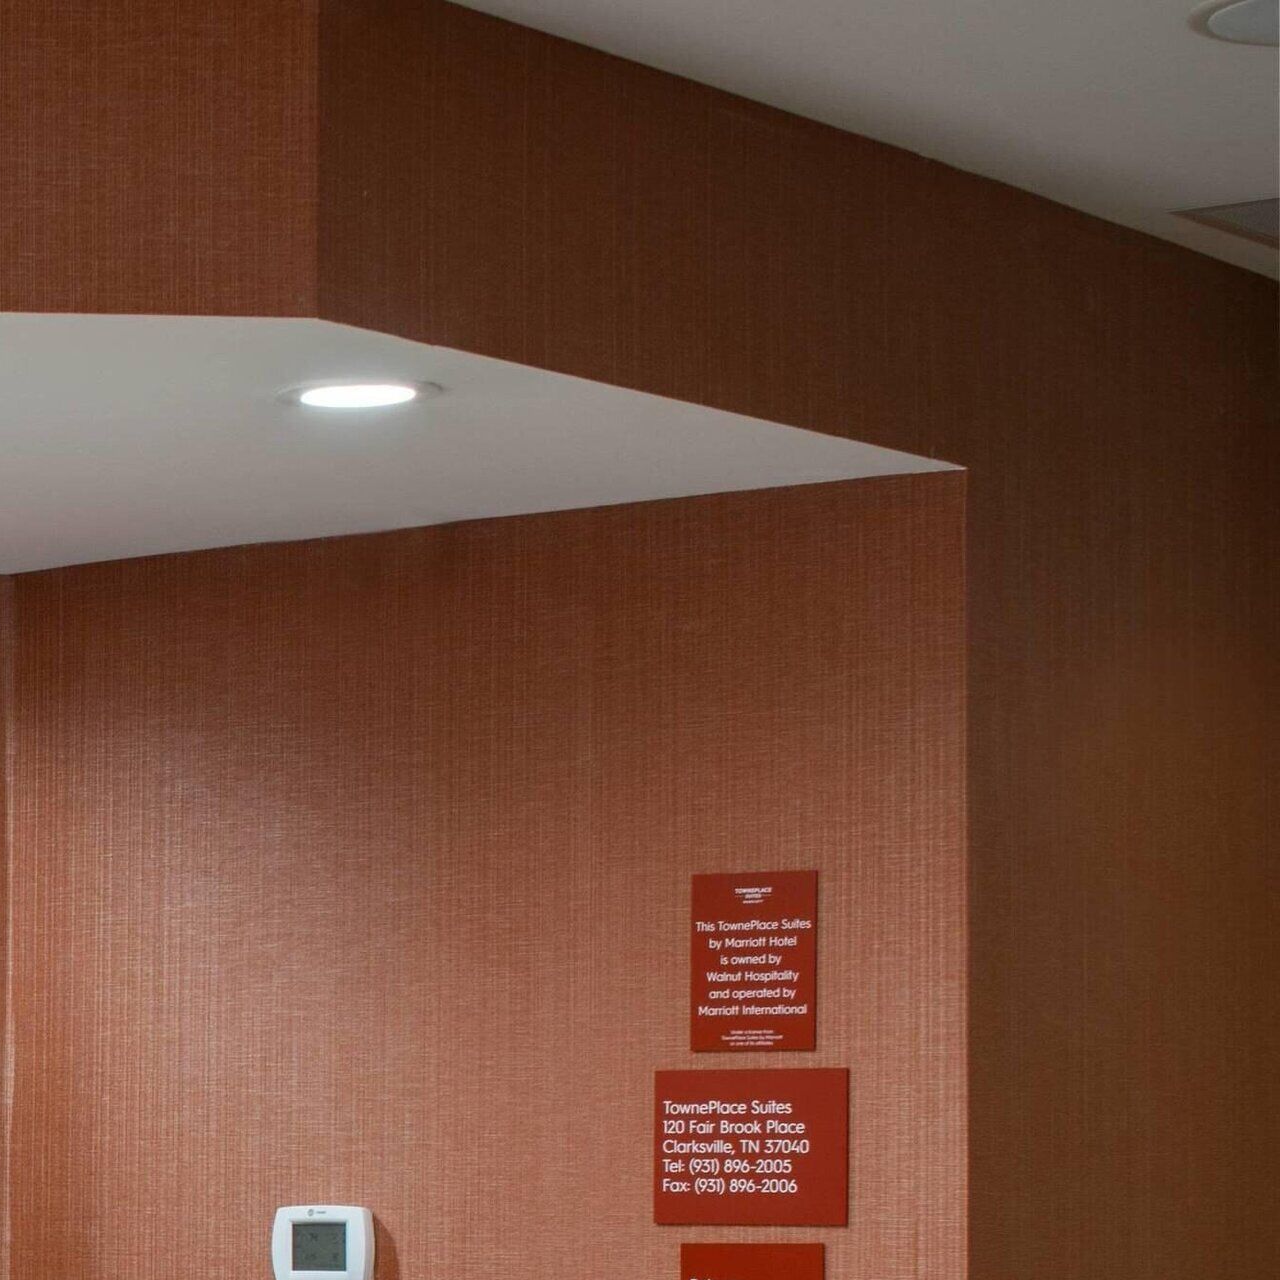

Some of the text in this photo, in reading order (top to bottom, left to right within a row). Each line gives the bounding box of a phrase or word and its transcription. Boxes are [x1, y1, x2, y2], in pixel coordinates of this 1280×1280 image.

[696, 919, 811, 931] This TownePlace Suites
[709, 936, 797, 950] by Marriott Hotel
[720, 954, 782, 965] is owned by
[707, 970, 799, 983] Walnut Hospitality
[709, 988, 796, 1000] and operated by
[698, 1004, 807, 1016] Marriott International
[663, 1100, 792, 1114] TownePlace Suites
[663, 1120, 805, 1134] 120 Fair Brook Place
[663, 1140, 809, 1155] Clarksville, TN 37040
[662, 1158, 792, 1175] Tel: (931) 896-2005
[663, 1178, 797, 1195] Fax: (931) 896-2006
